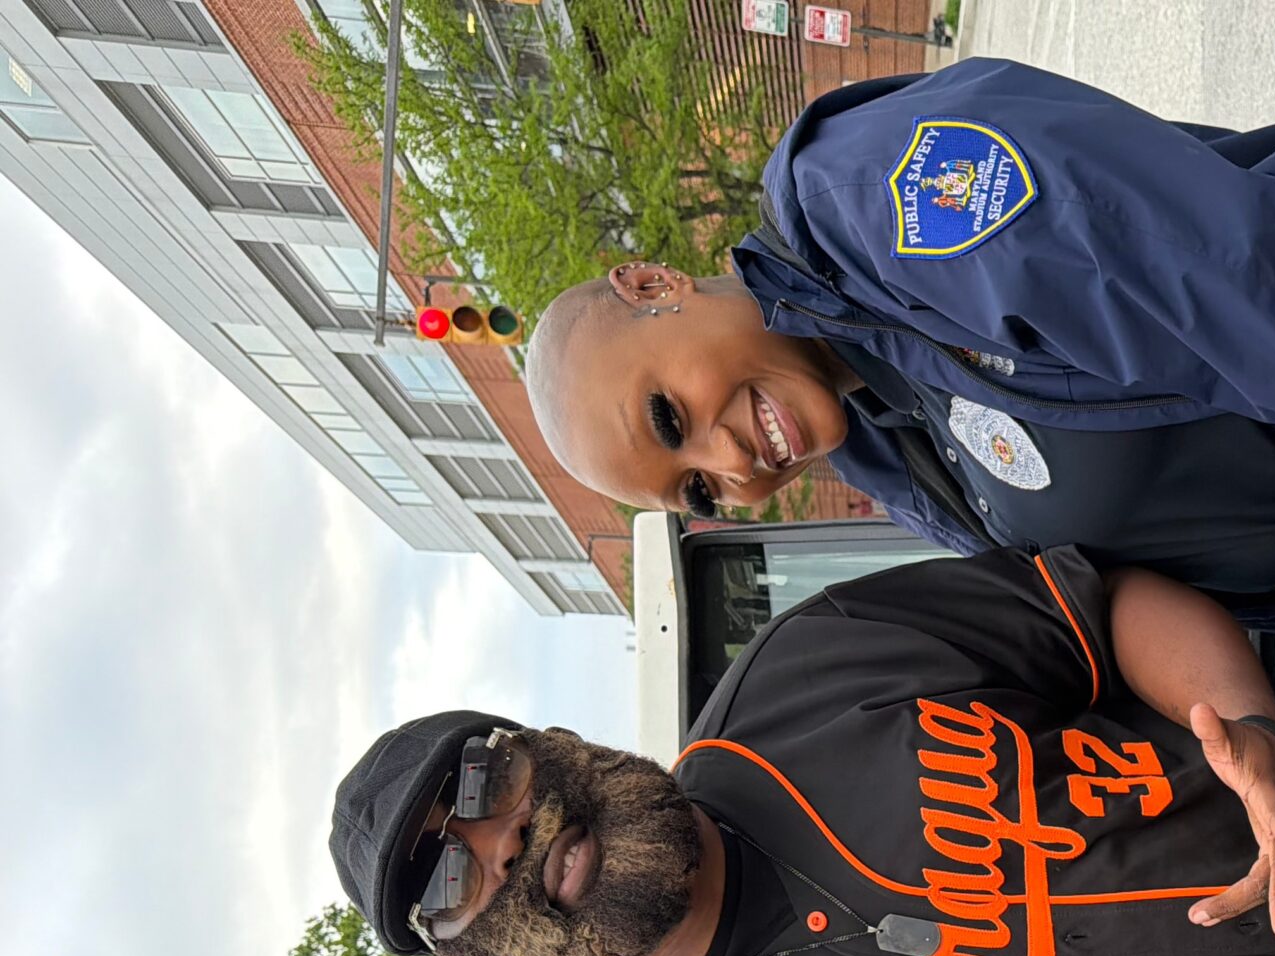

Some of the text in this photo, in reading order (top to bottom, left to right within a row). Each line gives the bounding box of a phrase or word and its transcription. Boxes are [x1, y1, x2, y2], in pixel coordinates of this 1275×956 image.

[904, 127, 941, 245] PUBLIC SAFETY
[968, 160, 987, 212] MARYLAND
[973, 143, 1000, 232] STADIUM AUTHORITY
[987, 155, 1014, 221] SECURITY
[1062, 729, 1174, 817] 32
